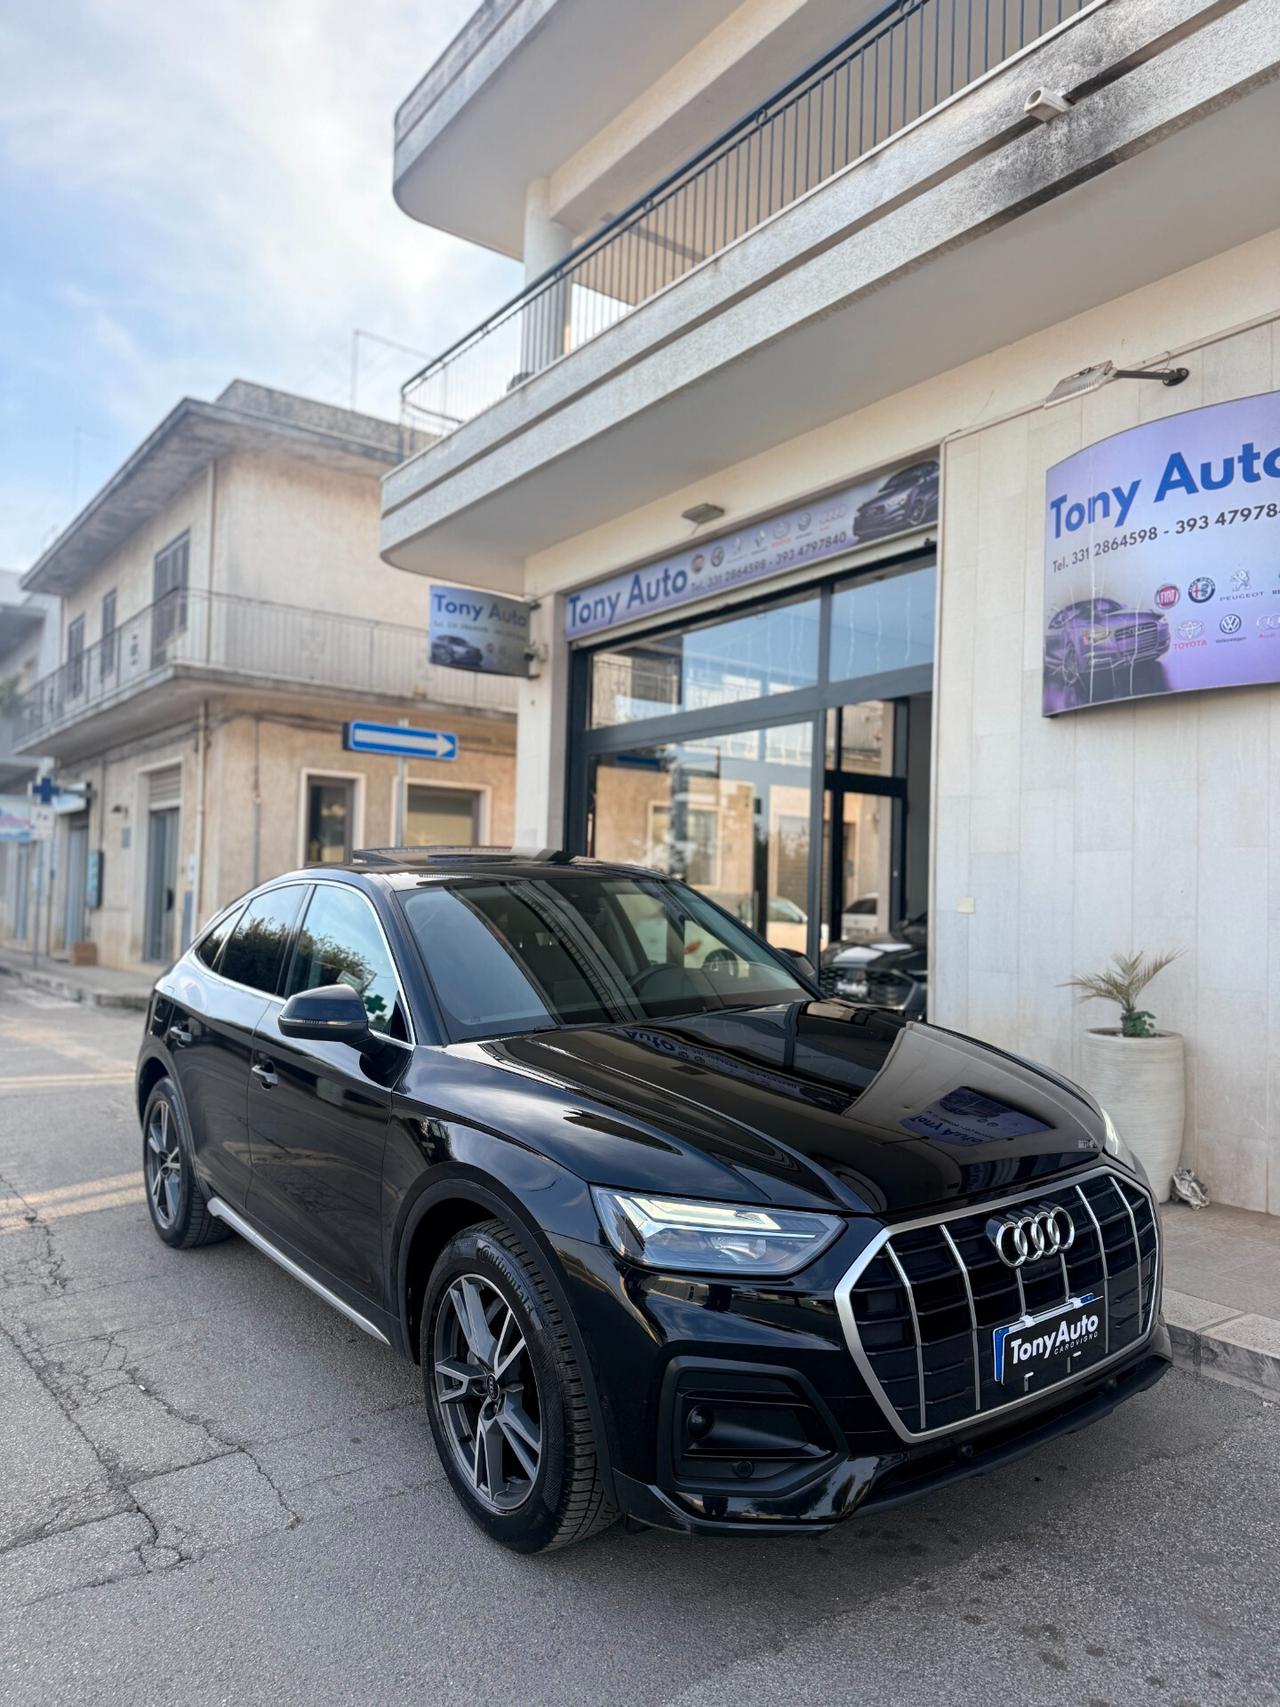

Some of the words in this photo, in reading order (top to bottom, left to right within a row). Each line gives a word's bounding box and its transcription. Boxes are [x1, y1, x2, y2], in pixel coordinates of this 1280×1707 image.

[1049, 478, 1142, 539] Tony
[1052, 556, 1069, 573] Tel.
[1071, 546, 1090, 565] 331
[1094, 526, 1158, 557] 2864598
[1175, 515, 1209, 534] 393
[1214, 503, 1280, 526] 47978
[433, 593, 483, 621] Tony
[488, 603, 528, 627] Auto
[569, 591, 621, 628] Tony
[627, 567, 688, 610] Auto
[1219, 591, 1264, 601] PEUGEOT
[1173, 640, 1207, 650] TOYOTA
[1010, 1314, 1099, 1364] TonyAuto
[1054, 1331, 1099, 1355] CAROVIGNO
